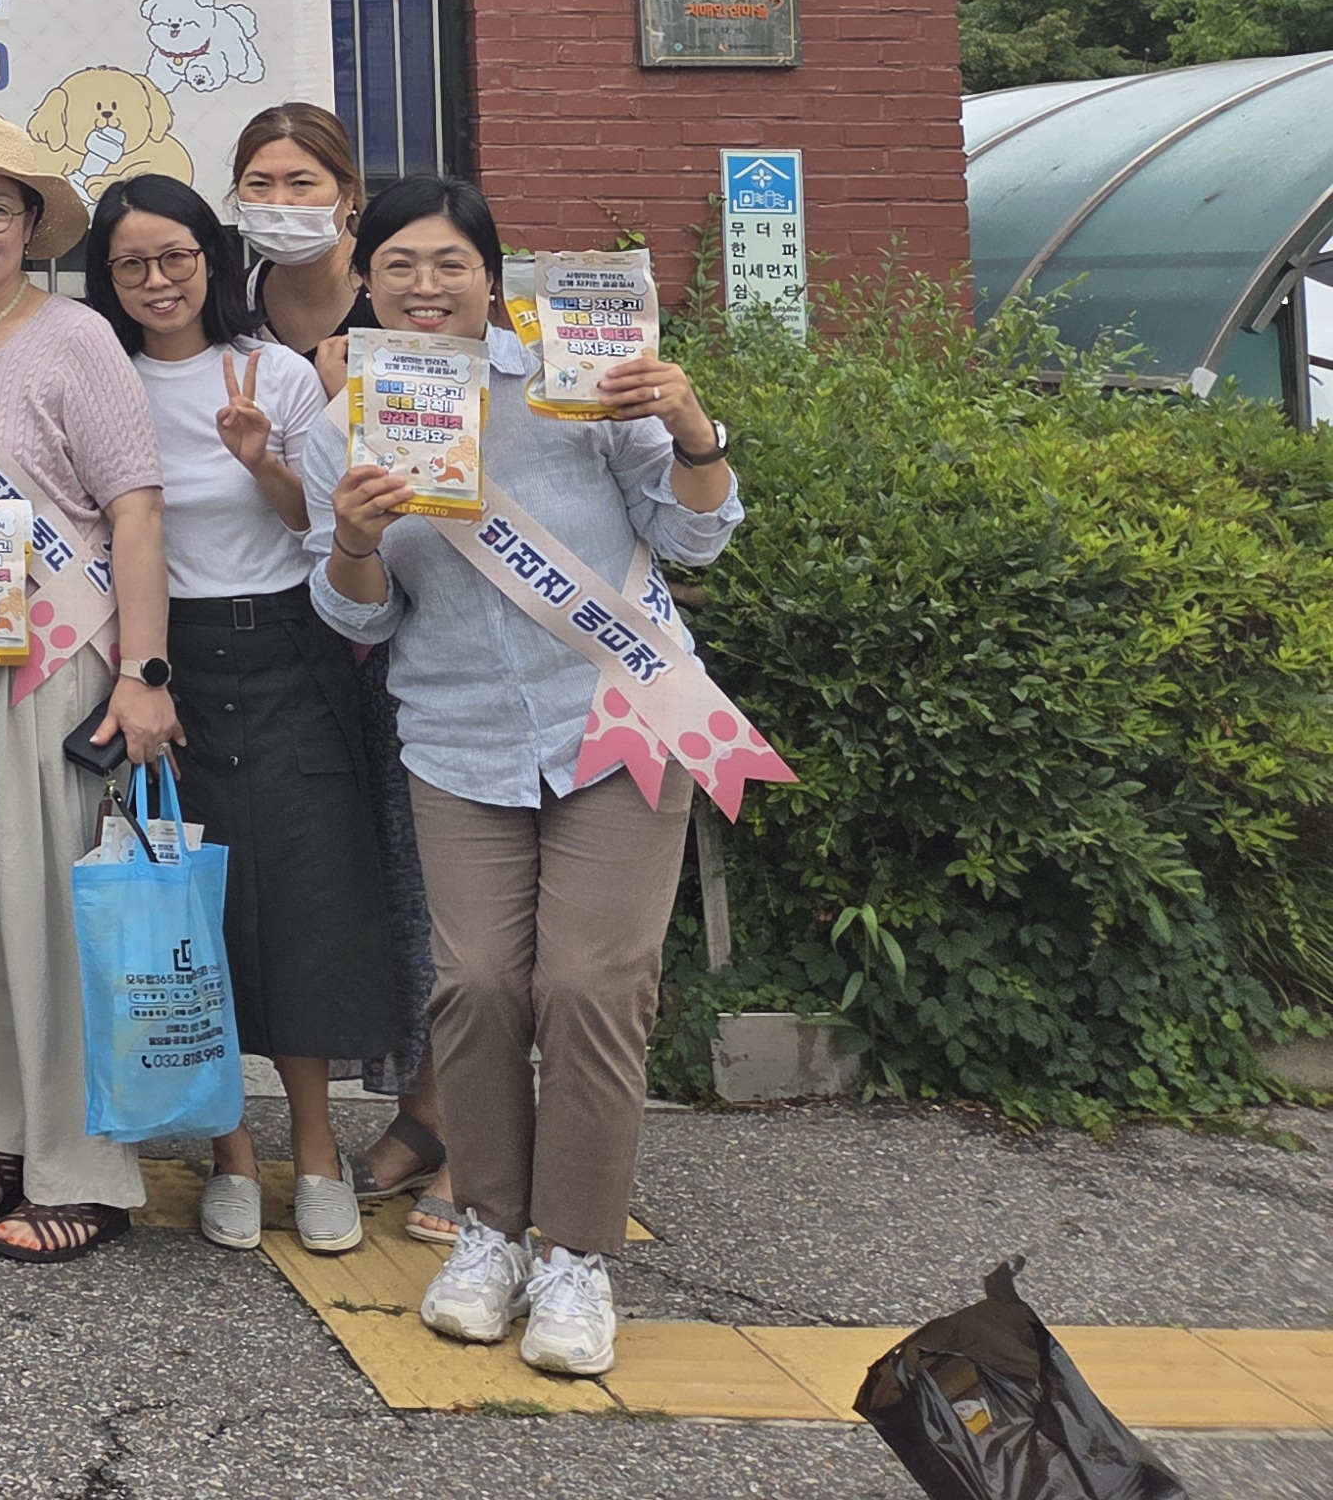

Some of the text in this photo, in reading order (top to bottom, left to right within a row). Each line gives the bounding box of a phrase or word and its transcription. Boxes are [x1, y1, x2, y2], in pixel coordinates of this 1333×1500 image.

[733, 263, 797, 279] 미세먼지
[550, 297, 642, 311] 배변은 치우고!
[557, 326, 643, 341] 반려견 에티켓
[568, 341, 635, 356] 꼭 지켜요~
[375, 379, 465, 400] 배변은 치우고!
[379, 410, 463, 430] 반려견 에티켓
[386, 426, 453, 443] 꼭 지켜요~
[409, 505, 448, 516] POTATO
[476, 517, 576, 606] 반려견
[570, 599, 672, 682] 에티켓
